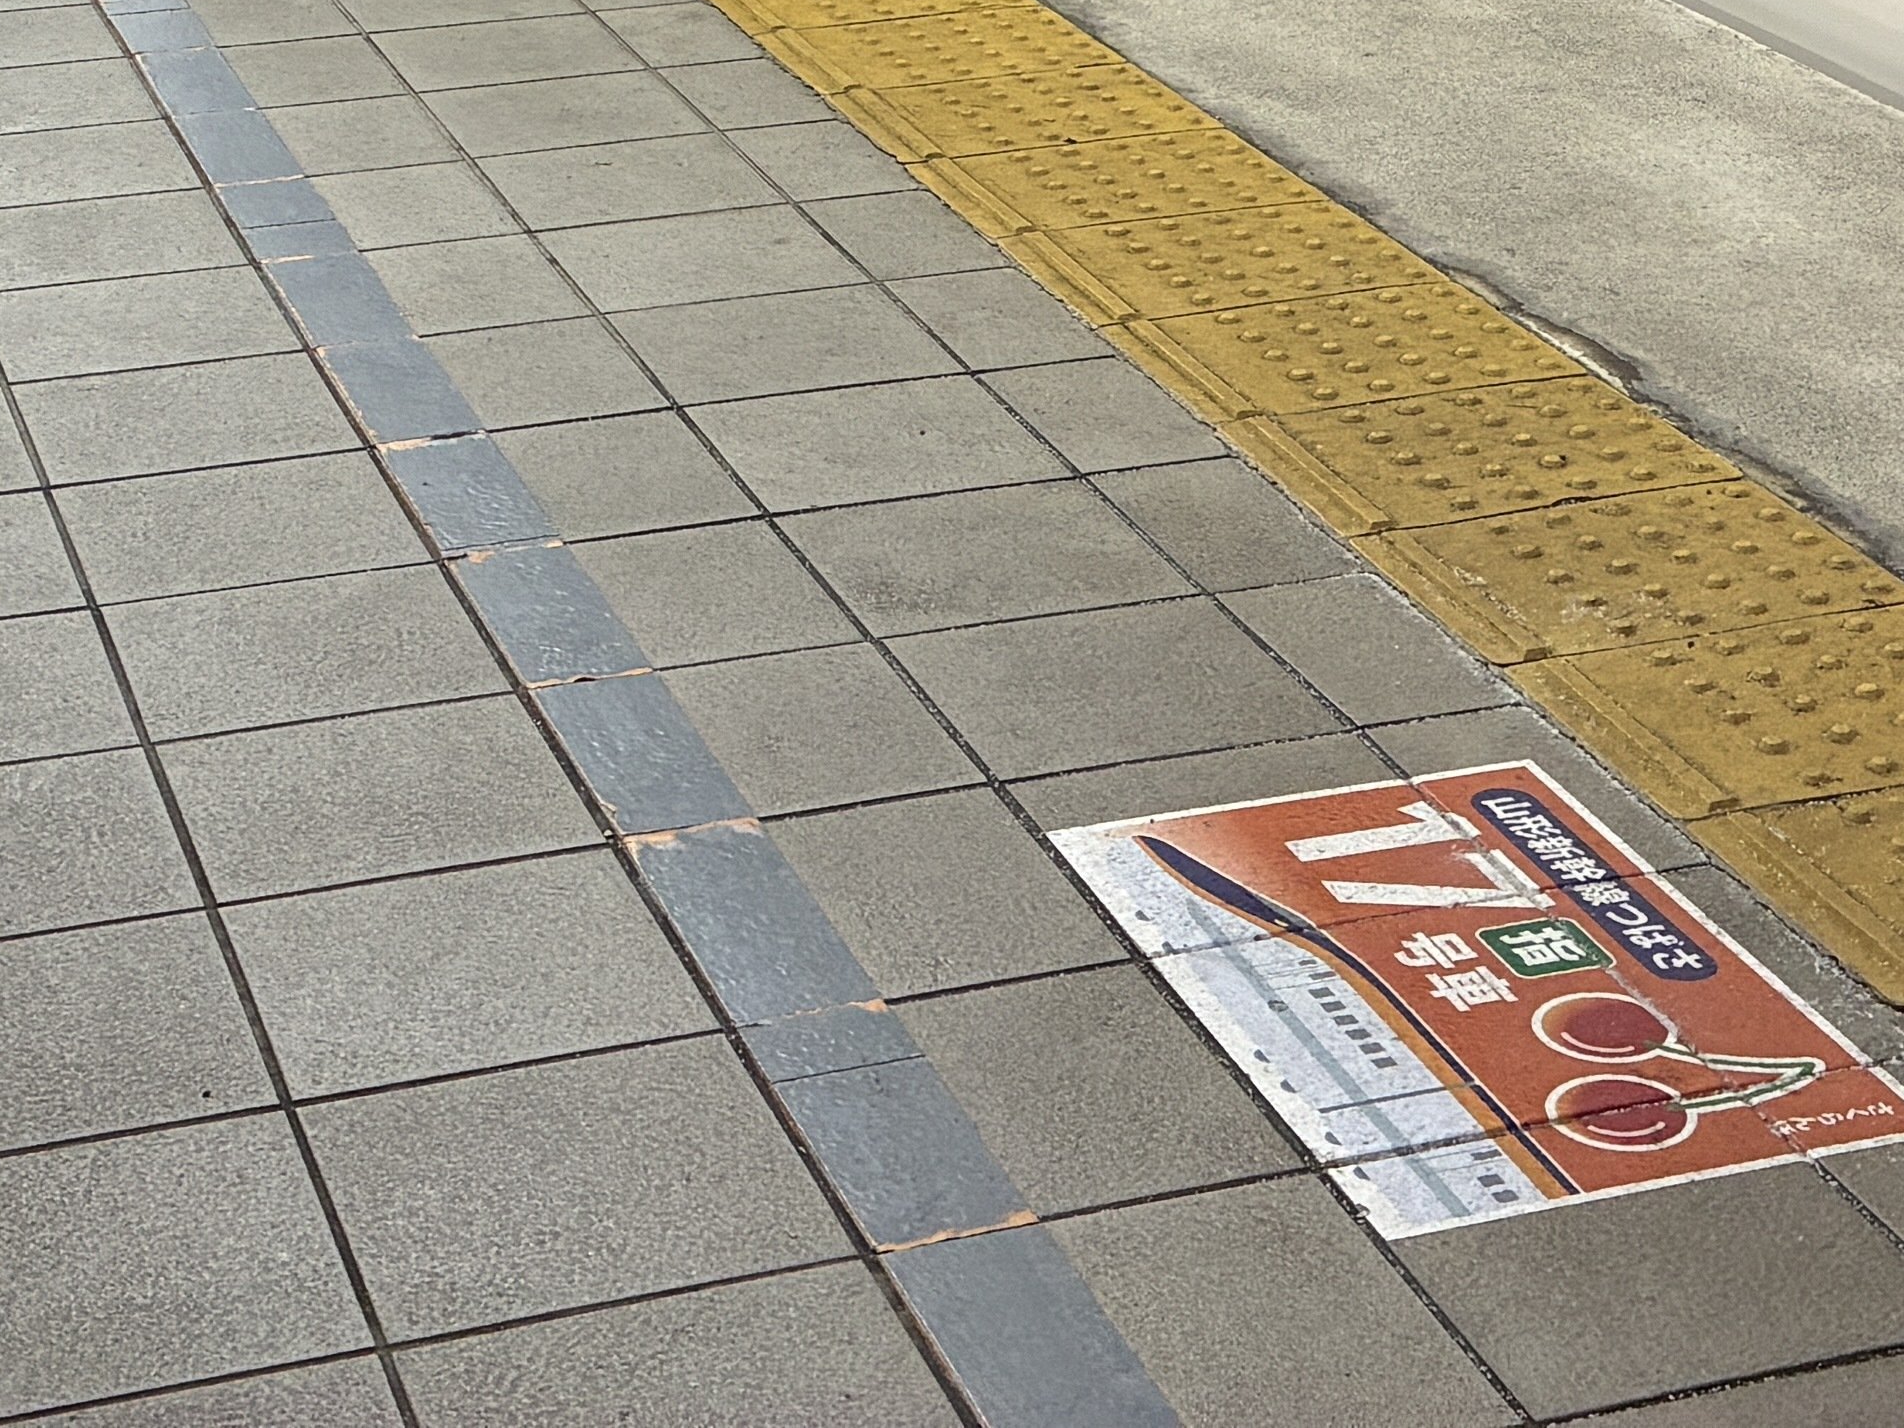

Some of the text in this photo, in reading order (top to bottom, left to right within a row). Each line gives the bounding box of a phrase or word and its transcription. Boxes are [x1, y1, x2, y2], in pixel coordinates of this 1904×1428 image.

[1285, 800, 1557, 910] 17
[1481, 796, 1707, 971] 山形新幹線つばさ
[1394, 932, 1519, 1012] 号車
[1500, 927, 1587, 966] 指
[1770, 1101, 1895, 1138] さくらんぼ
